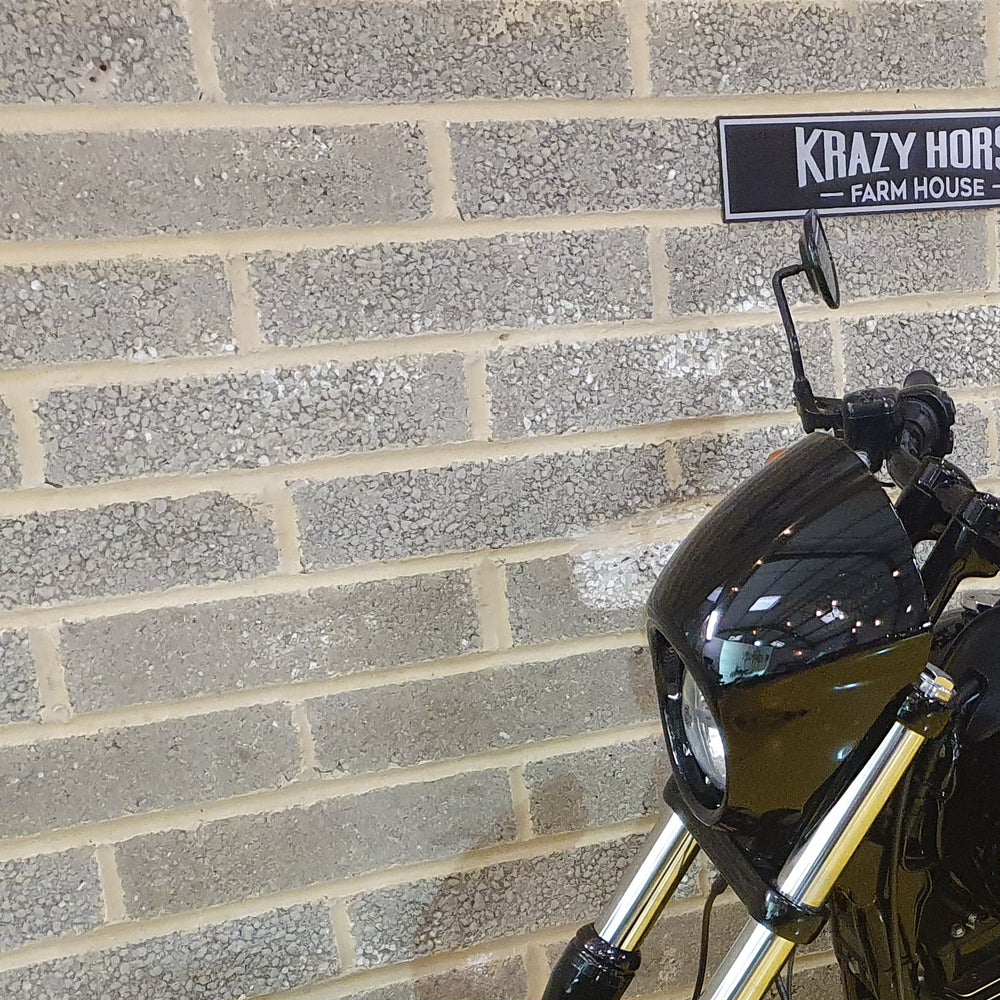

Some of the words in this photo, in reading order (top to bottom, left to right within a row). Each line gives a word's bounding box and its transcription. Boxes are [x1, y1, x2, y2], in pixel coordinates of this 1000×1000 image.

[795, 125, 916, 188] KRAZY
[851, 180, 908, 203] FARM
[913, 176, 985, 200] HOUSE
